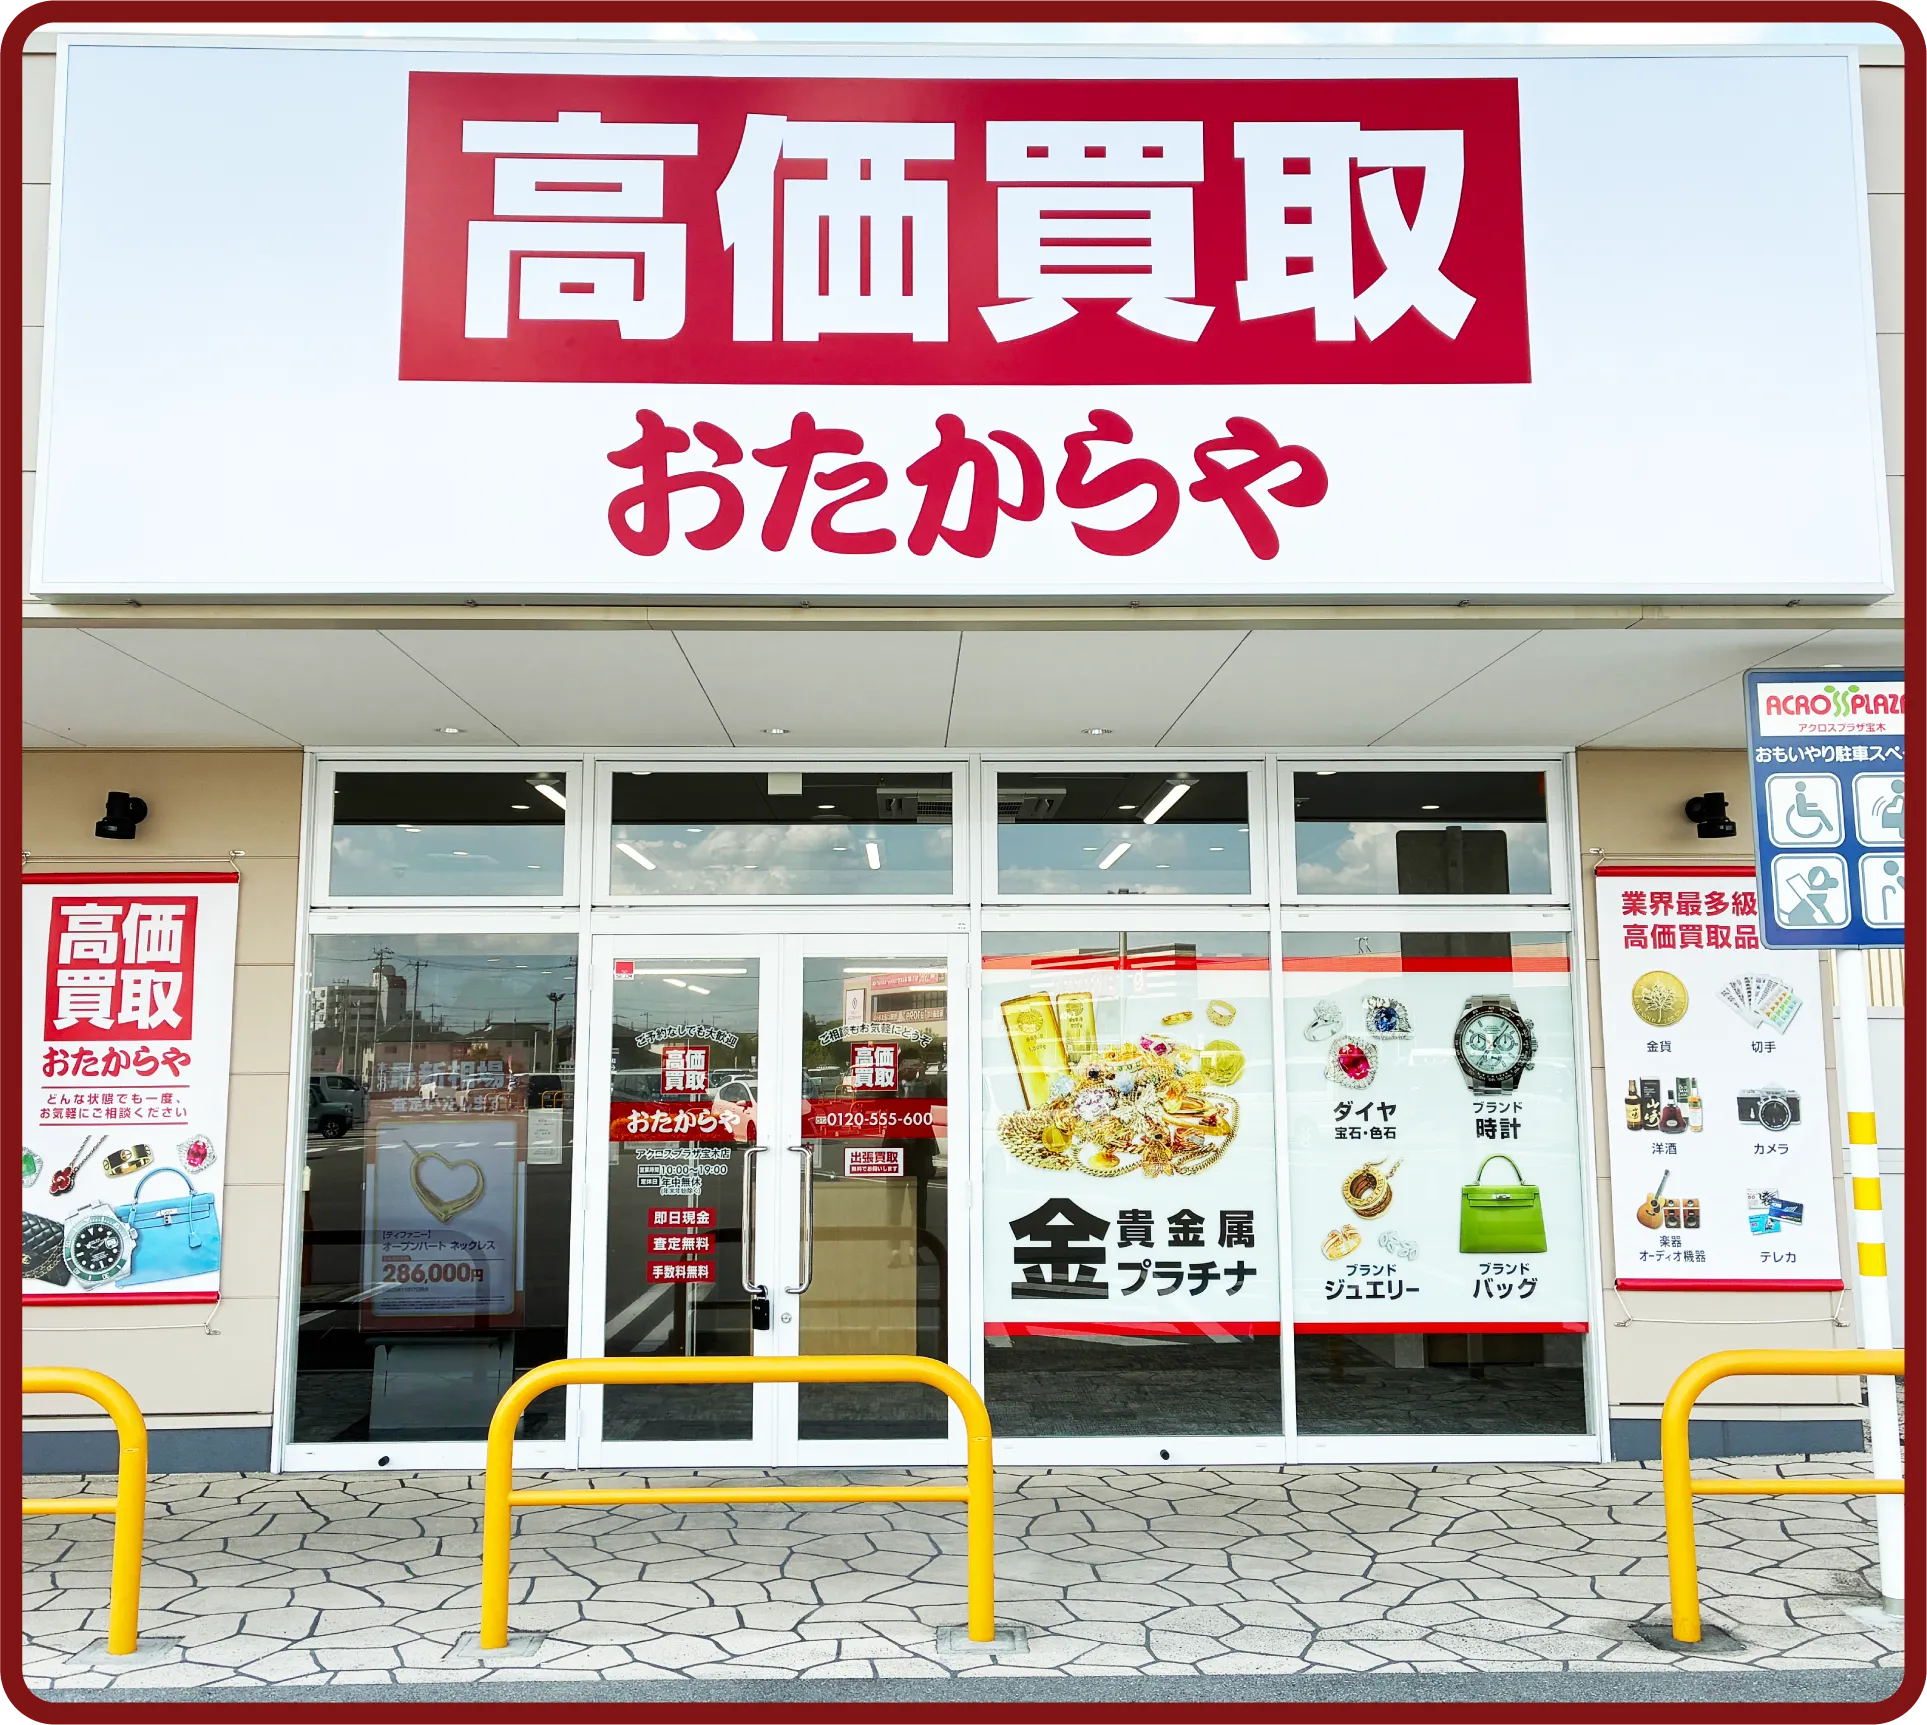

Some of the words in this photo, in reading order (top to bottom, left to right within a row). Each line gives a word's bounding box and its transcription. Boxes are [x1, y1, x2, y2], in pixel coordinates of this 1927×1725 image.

[461, 111, 1477, 344] 高価買取
[607, 408, 1329, 561] おたからや
[1799, 723, 1886, 732] アクロスプラザ宝木
[1622, 891, 1758, 917] 業界最多級
[59, 902, 186, 965] 高価
[1623, 924, 1760, 950] 高価買取品
[52, 970, 184, 1031] 買取
[634, 1025, 739, 1049] ご予約なしでも大歓迎
[818, 1023, 932, 1048] ご相談もお気軽にどうぞ
[1647, 1041, 1672, 1053] 金貨
[1751, 1041, 1777, 1053] 切手
[42, 1046, 191, 1077] おたからや
[665, 1049, 706, 1070] 高価
[854, 1047, 895, 1067] 高価
[665, 1071, 705, 1091] 買取
[855, 1068, 895, 1087] 買取
[47, 1093, 181, 1105] どんな状態でも一度、
[40, 1107, 187, 1119] お気軽にご相談ください
[1333, 1101, 1397, 1122] ダイヤ
[1472, 1101, 1523, 1114] ブランド
[627, 1108, 740, 1134] おたからや
[827, 1112, 933, 1126] 0120-555-600
[1335, 1126, 1396, 1140] 宝石・色石
[1475, 1117, 1521, 1139] 時計
[636, 1148, 731, 1159] アクロスプラザ宝木店
[1652, 1143, 1677, 1155] 洋酒
[1754, 1143, 1789, 1155] カメラ
[850, 1151, 898, 1164] 出張買取
[661, 1178, 702, 1187] 年中無休
[654, 1210, 710, 1224] 即日現金
[1116, 1208, 1255, 1248] 貴金属
[382, 1241, 446, 1251] オープンハート
[450, 1240, 496, 1250] ネックレス
[653, 1237, 709, 1250] 査定無料
[1009, 1197, 1111, 1299] 金
[1659, 1236, 1682, 1248] 楽器
[1639, 1250, 1706, 1263] オーディオ機器
[1760, 1252, 1797, 1263] テレカ
[382, 1263, 483, 1283] 286,000円
[652, 1265, 709, 1279] 手数料無料
[1117, 1258, 1257, 1296] プラチナ
[1346, 1263, 1397, 1277] ブランド
[1479, 1262, 1530, 1276] ブランド
[1325, 1280, 1420, 1300] ジュエリー
[1473, 1278, 1538, 1300] バッグ
